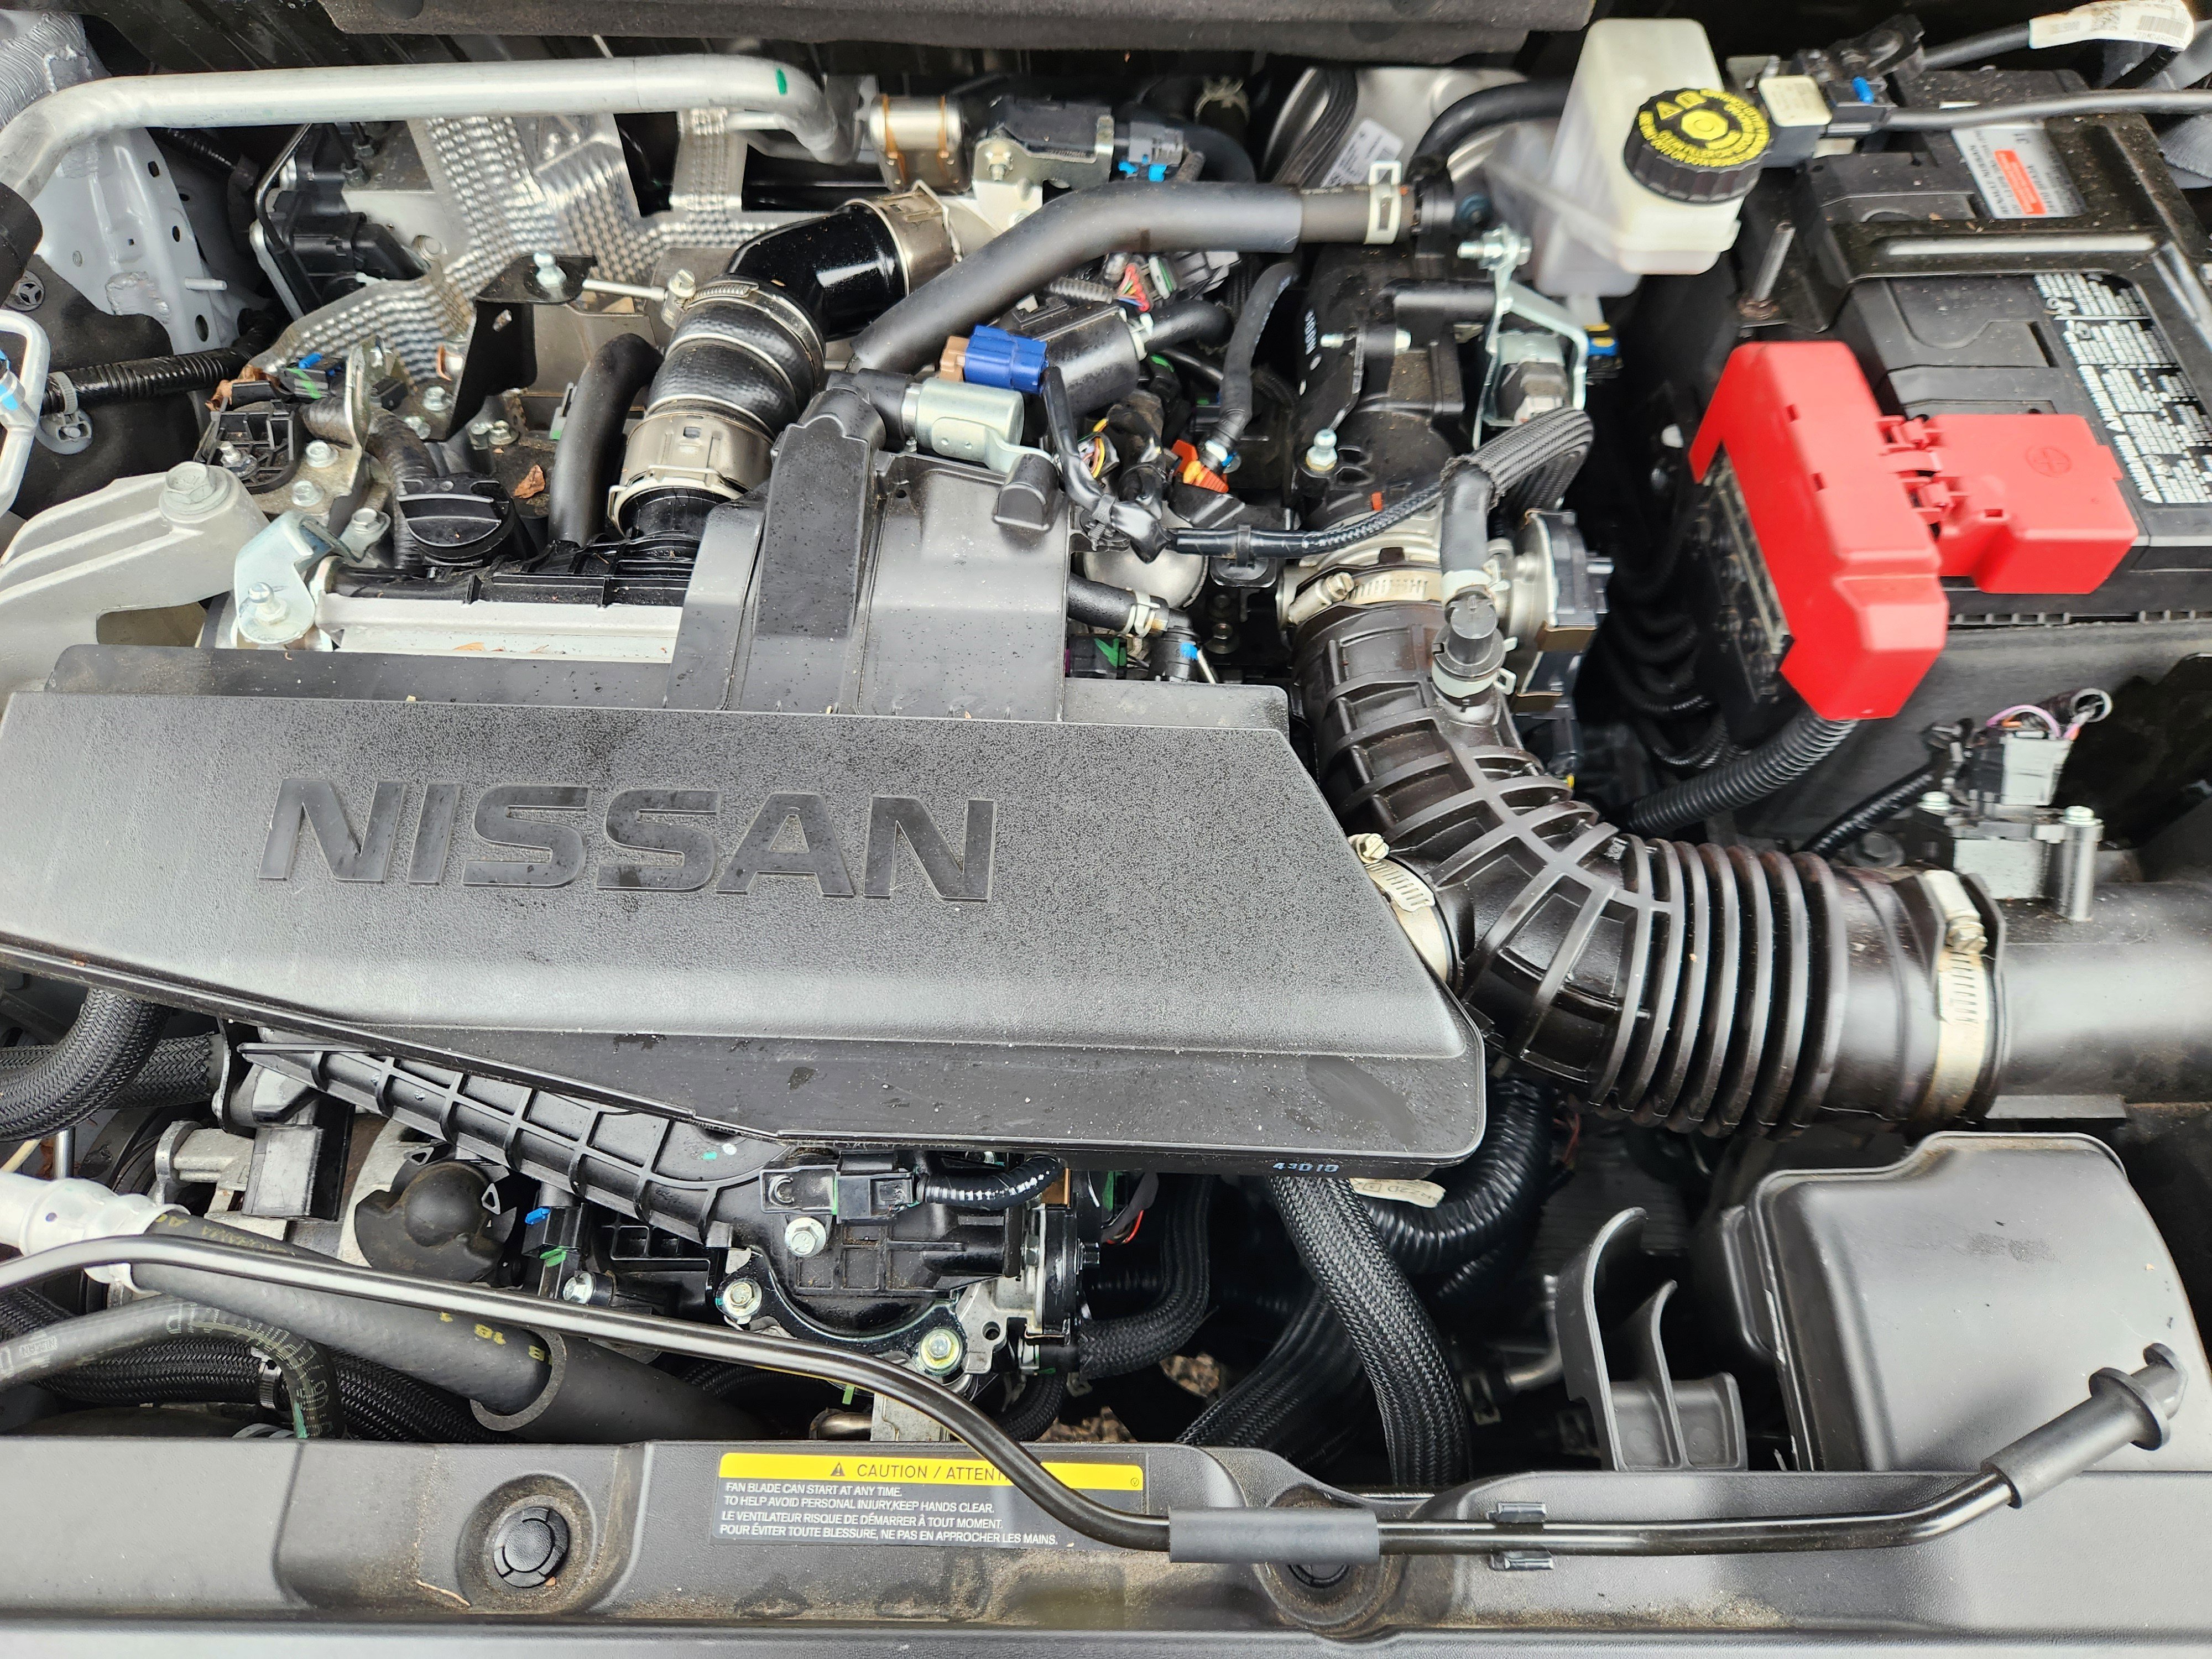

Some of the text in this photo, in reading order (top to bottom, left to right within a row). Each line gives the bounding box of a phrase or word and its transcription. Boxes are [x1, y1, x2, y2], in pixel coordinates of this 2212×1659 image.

[258, 779, 998, 902] NISSAN
[857, 1464, 928, 1479] CAUTION
[933, 1466, 941, 1479] /
[726, 1483, 903, 1497] FAN BLADE CAN START AT ANY TIME.
[724, 1496, 739, 1506] TO
[740, 1496, 768, 1506] HELP
[767, 1497, 800, 1507] AVOID
[801, 1498, 856, 1509] PERSONAL
[920, 1501, 957, 1512] HANDS
[958, 1503, 995, 1514] CLEAR.
[721, 1511, 735, 1521] LE
[737, 1511, 802, 1523] VENTILATEUR
[804, 1513, 843, 1525] RISQUE
[843, 1515, 858, 1525] DE
[859, 1512, 918, 1527] DÉMARRER
[927, 1517, 956, 1528] TOUT
[956, 1519, 1003, 1529] MOMENT.
[720, 1522, 1058, 1546] POUR ÉVITER TOUTE BLESSURE, NE PAS EN APPROCHER LES MAINS.
